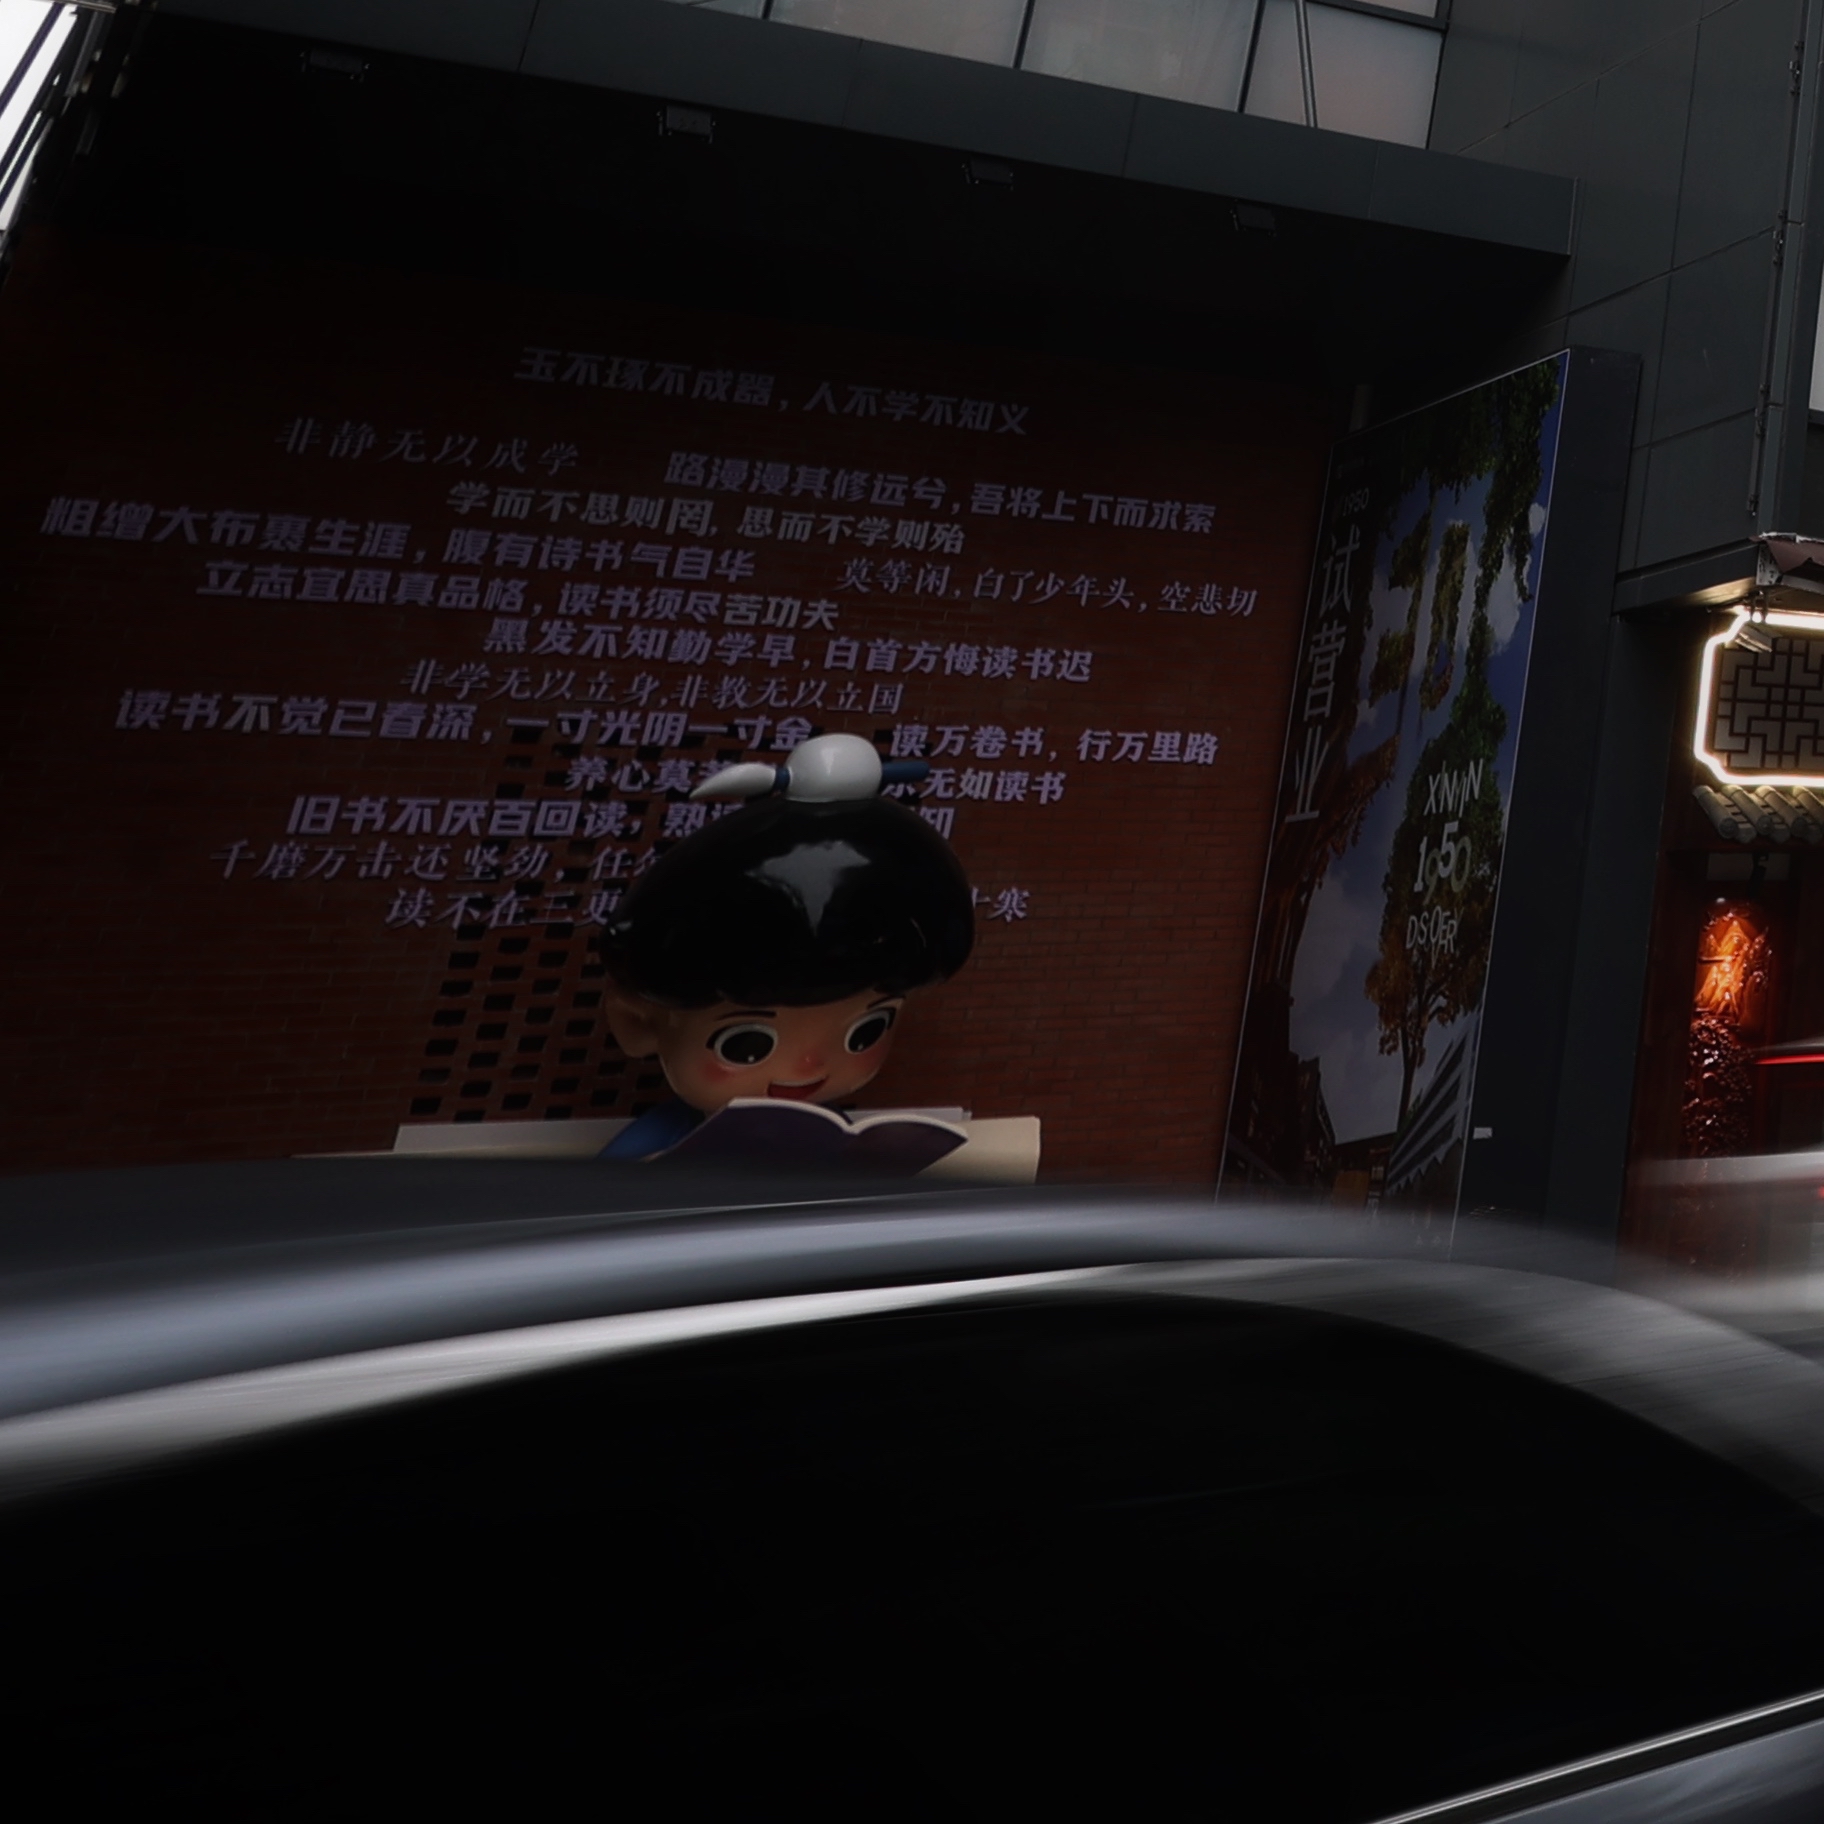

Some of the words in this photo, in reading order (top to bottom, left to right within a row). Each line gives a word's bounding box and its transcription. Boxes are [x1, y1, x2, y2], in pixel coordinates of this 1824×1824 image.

[273, 415, 581, 478] 非静无以成学
[1284, 530, 1361, 824] 试营业
